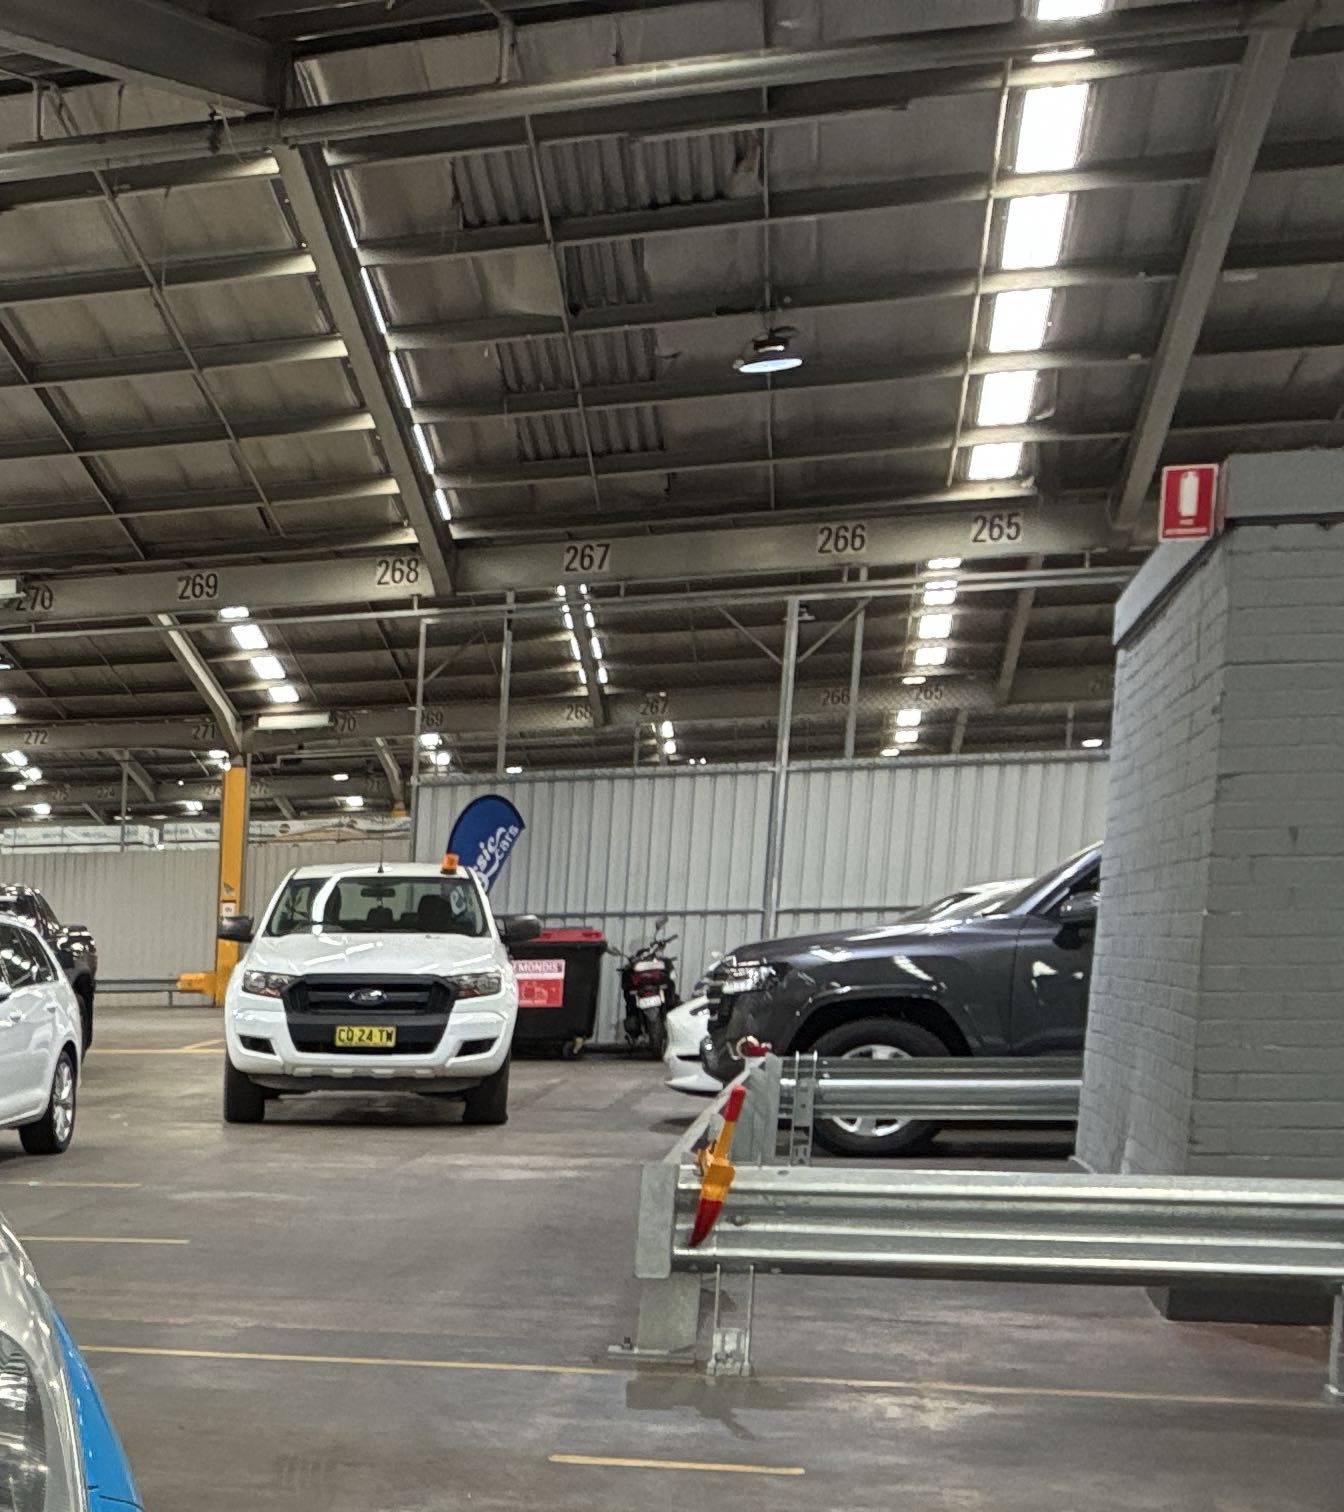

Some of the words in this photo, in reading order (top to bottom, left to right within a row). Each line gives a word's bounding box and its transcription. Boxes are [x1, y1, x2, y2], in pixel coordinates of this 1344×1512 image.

[818, 524, 866, 554] 266
[972, 514, 1021, 543] 265
[377, 558, 420, 586] 268
[564, 543, 611, 573] 267
[178, 572, 219, 600] 269
